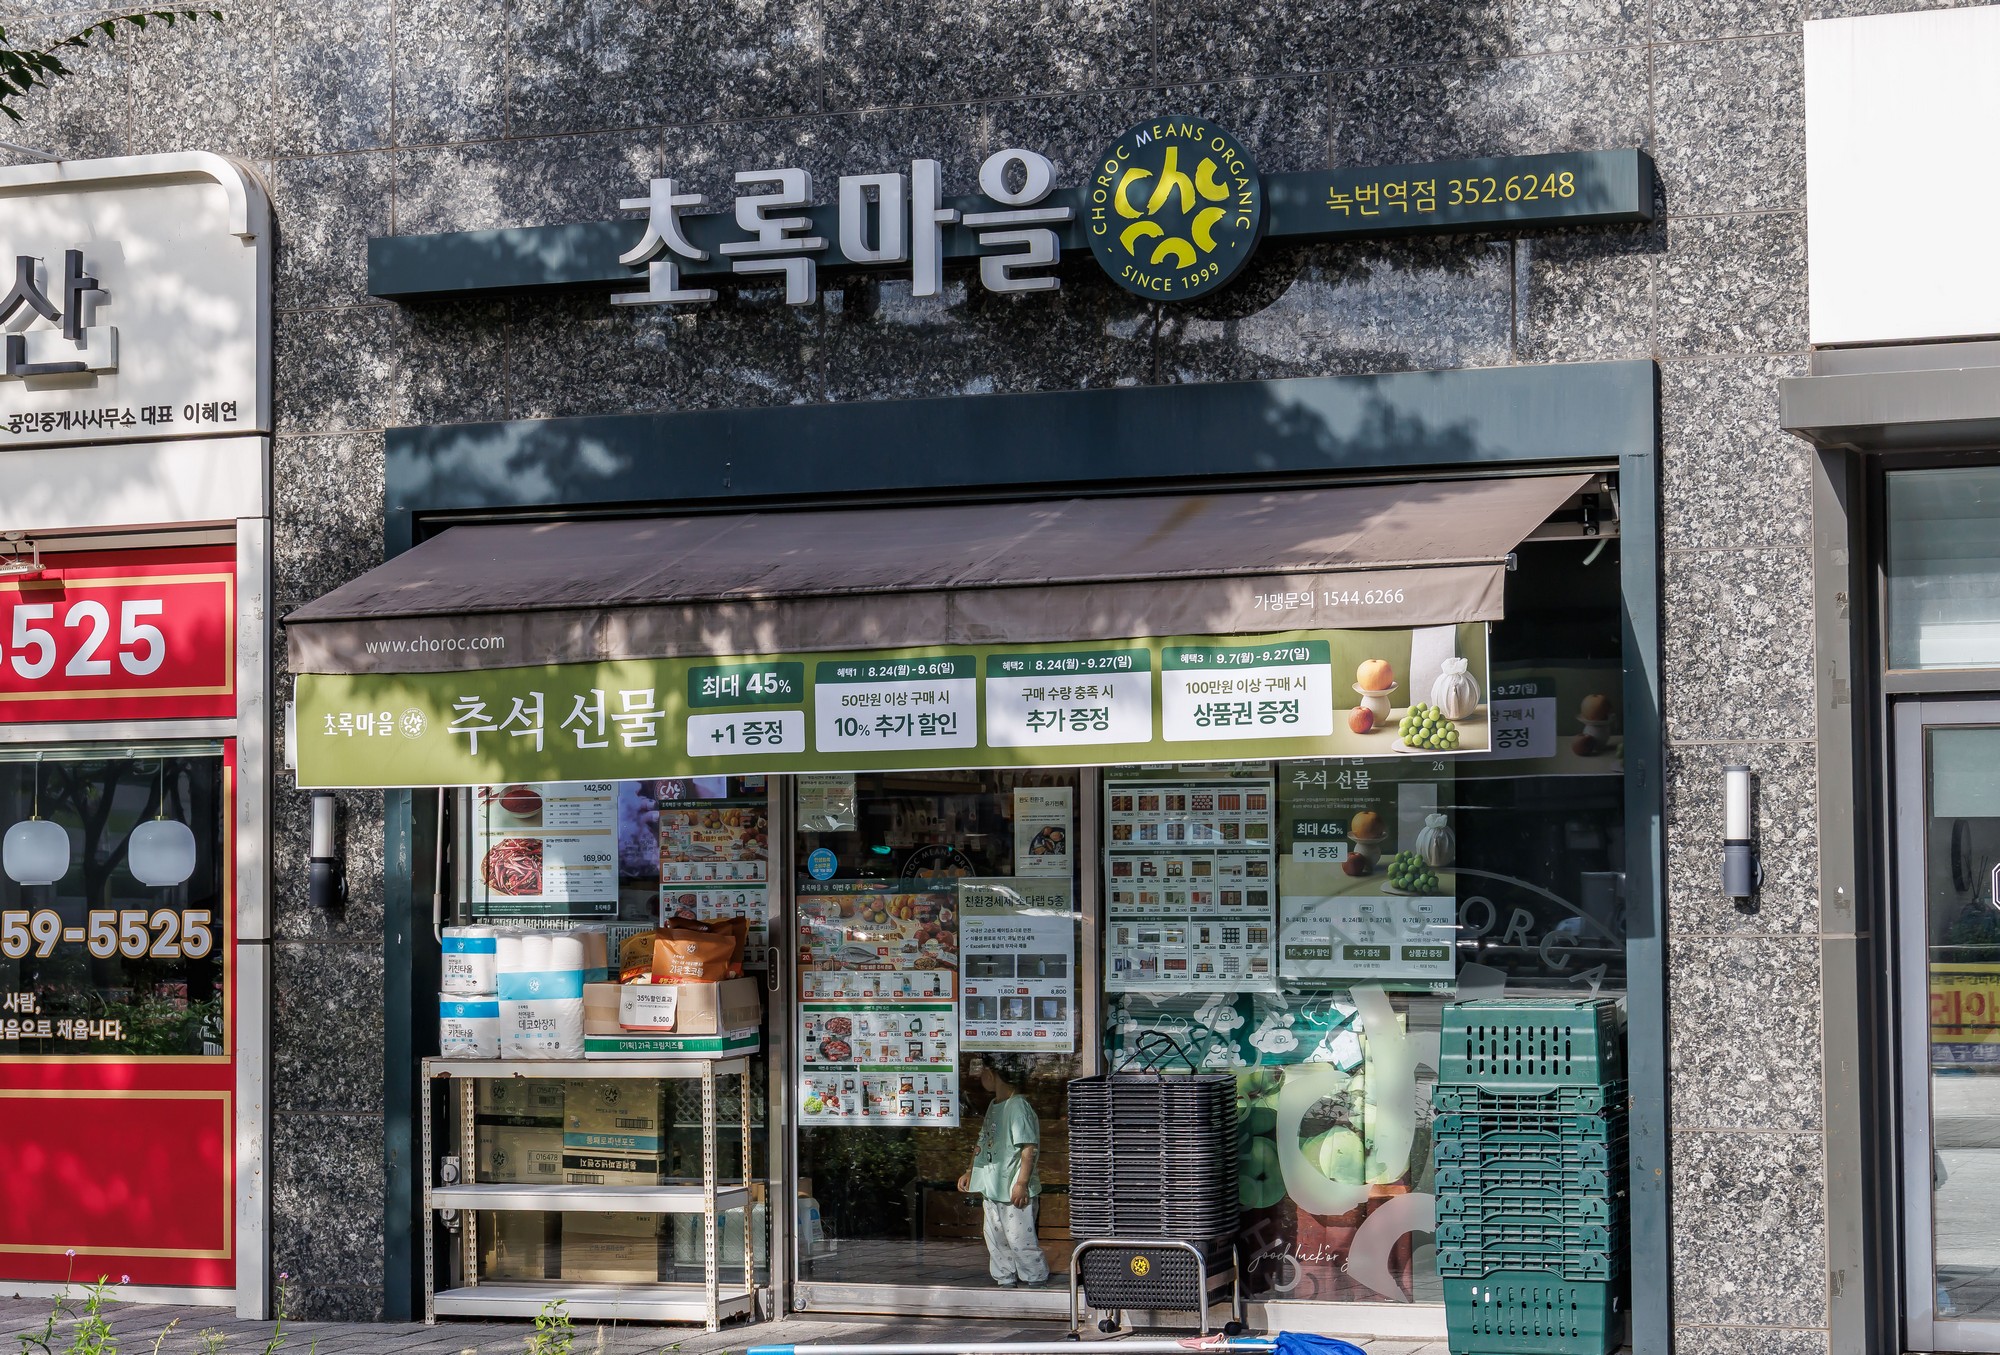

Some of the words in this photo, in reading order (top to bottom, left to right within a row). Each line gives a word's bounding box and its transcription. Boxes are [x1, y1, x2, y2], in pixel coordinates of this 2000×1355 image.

[1091, 145, 1130, 235] CHOROC
[1135, 123, 1205, 148] MEANS
[1211, 137, 1253, 230] ORGANIC
[1326, 178, 1437, 217] 녹번역점
[1448, 171, 1576, 206] 352.6248
[610, 148, 1075, 306] 초록마을
[1121, 265, 1172, 291] SINCE
[1181, 262, 1219, 289] 1999
[7, 408, 136, 434] 공인중개사사무소
[141, 405, 173, 425] 대표
[183, 400, 237, 423] 이혜연
[1253, 590, 1315, 611] 가맹문의
[1322, 588, 1404, 606] 1544.6266
[0, 599, 166, 678] 525
[365, 635, 505, 654] www.choroc.com
[1002, 659, 1024, 671] 혜택2
[1180, 652, 1204, 664] 혜택3
[836, 667, 857, 678] 혜택1
[701, 674, 740, 698] 최대
[745, 672, 791, 694] 45%
[1021, 687, 1045, 701] 구매
[1047, 685, 1072, 701] 수량
[1075, 685, 1098, 700] 충족
[1101, 684, 1114, 699] 시
[1185, 679, 1233, 694] 100만원
[1236, 677, 1261, 693] 이상
[1264, 676, 1291, 692] 구매
[1294, 675, 1307, 692] 시
[841, 693, 881, 707] 50만원
[884, 692, 908, 706] 이상
[910, 691, 935, 705] 구매
[938, 690, 950, 704] 시
[447, 691, 545, 756] 추석
[560, 688, 666, 749] 선물
[1025, 709, 1066, 733] 추가
[1068, 706, 1110, 731] 증정
[1193, 701, 1252, 728] 상품권
[1257, 698, 1300, 724] 증정
[1503, 709, 1522, 721] 구매
[1525, 707, 1535, 720] 시
[323, 711, 395, 737] 초록마을
[710, 723, 735, 744] +1
[741, 719, 783, 746] 증정
[834, 717, 870, 737] 10%
[874, 714, 914, 737] 추가
[918, 711, 958, 736] 할인
[1496, 727, 1529, 748] 증정
[1432, 761, 1445, 771] 26
[583, 784, 612, 792] 142,500
[1292, 770, 1327, 791] 추석
[1335, 769, 1371, 790] 선물
[1297, 823, 1318, 836] 최대
[1320, 823, 1343, 835] 45%
[583, 854, 612, 863] 169,900
[1302, 847, 1315, 858] +1
[1317, 846, 1338, 859] 증정
[965, 895, 1014, 908] 친환경세제
[1015, 895, 1045, 907] 소다랩
[1047, 895, 1064, 907] 5종
[1, 909, 213, 959] 59-5525
[1302, 949, 1315, 957] 추가
[1316, 949, 1330, 957] 할인
[1353, 949, 1366, 957] 추가
[1367, 949, 1380, 957] 증정
[1408, 949, 1428, 957] 상품권
[1429, 949, 1443, 957] 증정
[448, 964, 473, 974] 키친타올
[3, 992, 41, 1015] 사람,
[57, 1019, 127, 1041] 채웁니다.
[448, 1028, 474, 1038] 키친타올
[518, 1019, 556, 1031] 데코화장지
[619, 1041, 637, 1050] [기획]
[638, 1041, 650, 1050] 21곡
[535, 1153, 559, 1161] 016478
[1247, 1243, 1291, 1272] good
